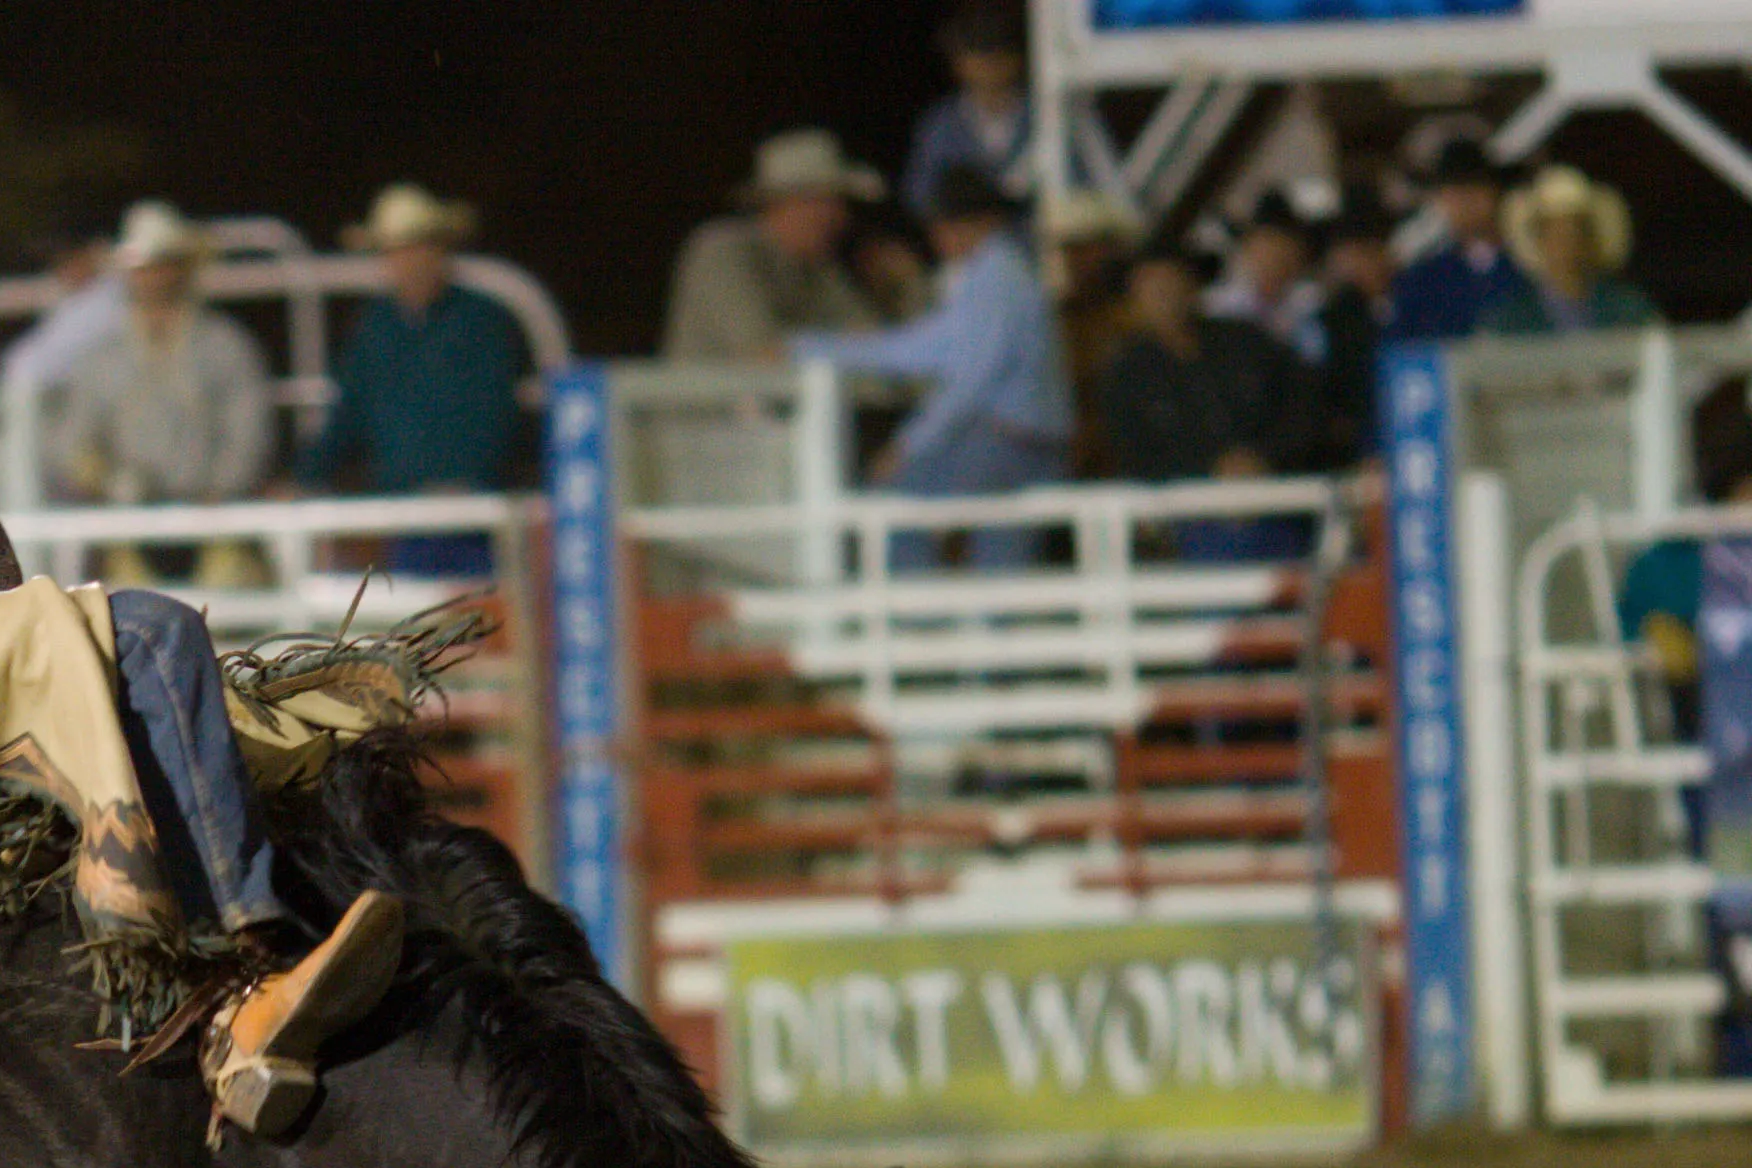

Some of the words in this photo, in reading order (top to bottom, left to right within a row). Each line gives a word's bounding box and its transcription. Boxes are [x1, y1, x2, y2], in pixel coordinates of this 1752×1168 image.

[1391, 369, 1450, 918] PRESCOTT
[750, 967, 962, 1106] DIRT
[980, 955, 1363, 1097] WORKS
